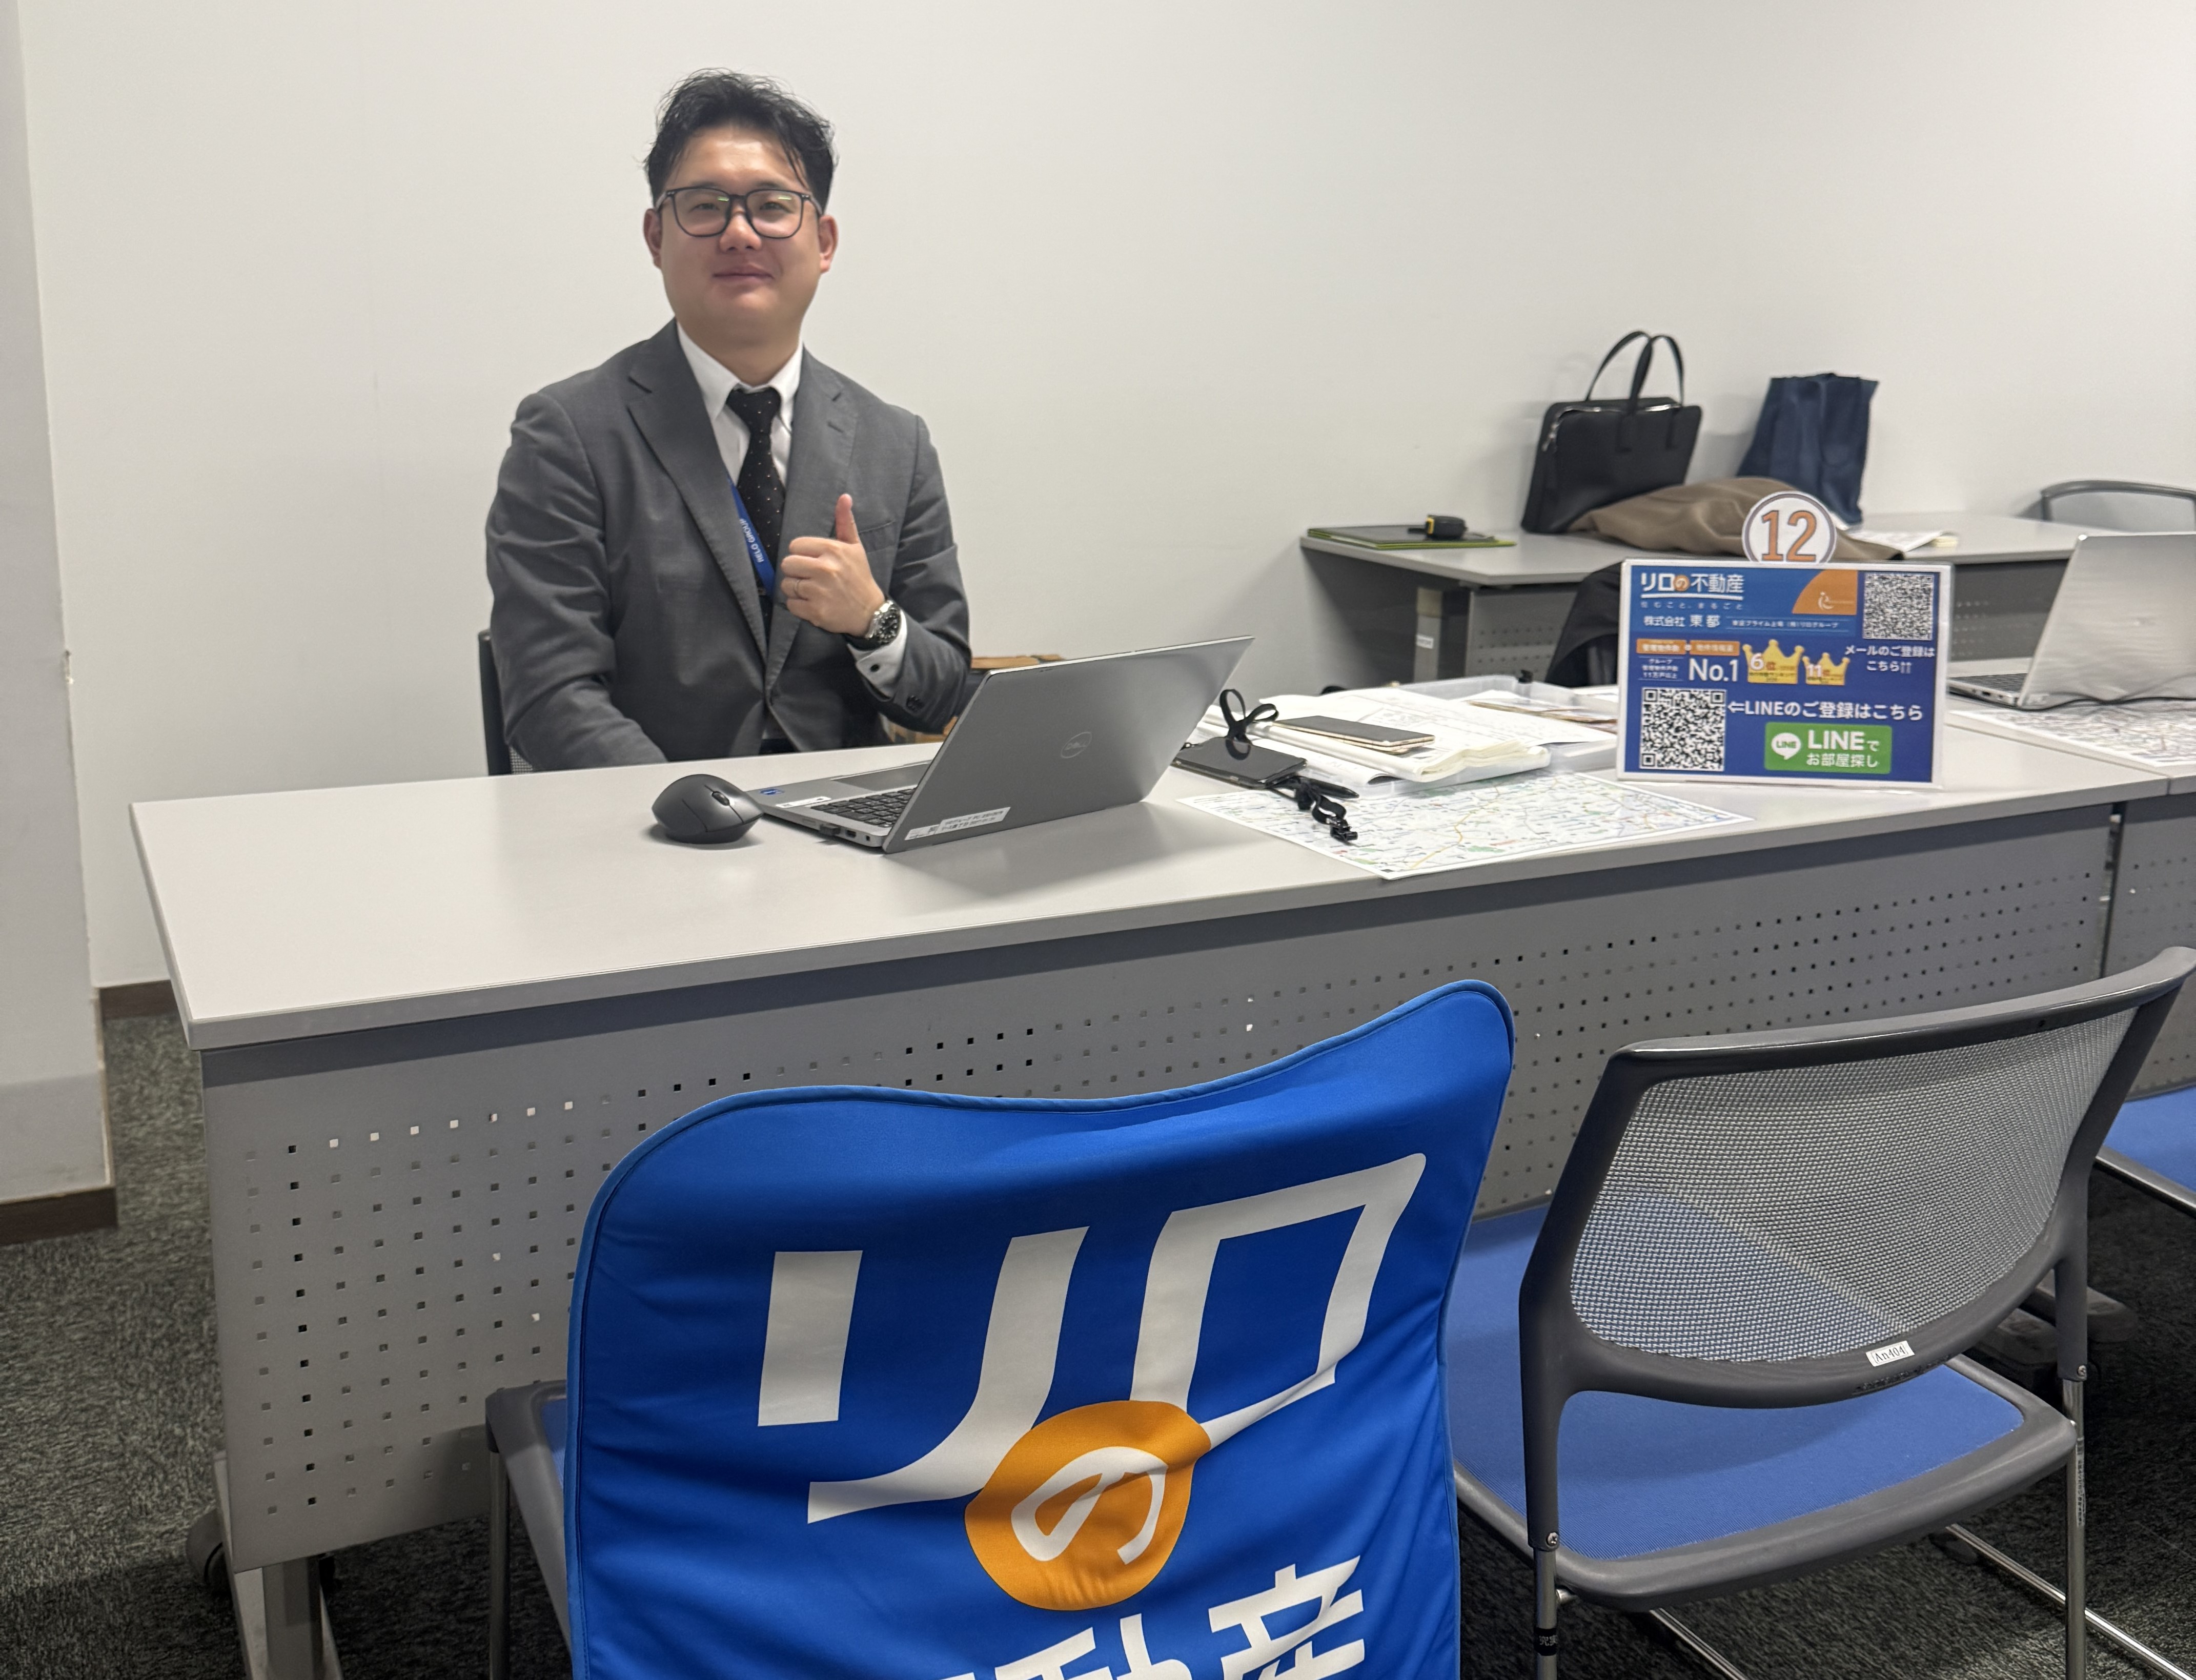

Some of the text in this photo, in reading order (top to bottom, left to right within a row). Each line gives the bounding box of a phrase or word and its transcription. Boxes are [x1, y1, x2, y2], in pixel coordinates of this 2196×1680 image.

[1761, 509, 1818, 562] 12
[750, 543, 764, 562] RELO
[1641, 572, 1744, 593] リロの不動産
[1644, 616, 1685, 627] 株式会社
[1845, 645, 1935, 657] メールのご登録は
[1689, 658, 1738, 682] No.1
[1866, 661, 1900, 672] こちら
[1745, 701, 1923, 721] LINEのご登録はこちら
[1776, 740, 1797, 749] LINE
[1806, 752, 1878, 768] お部屋探し
